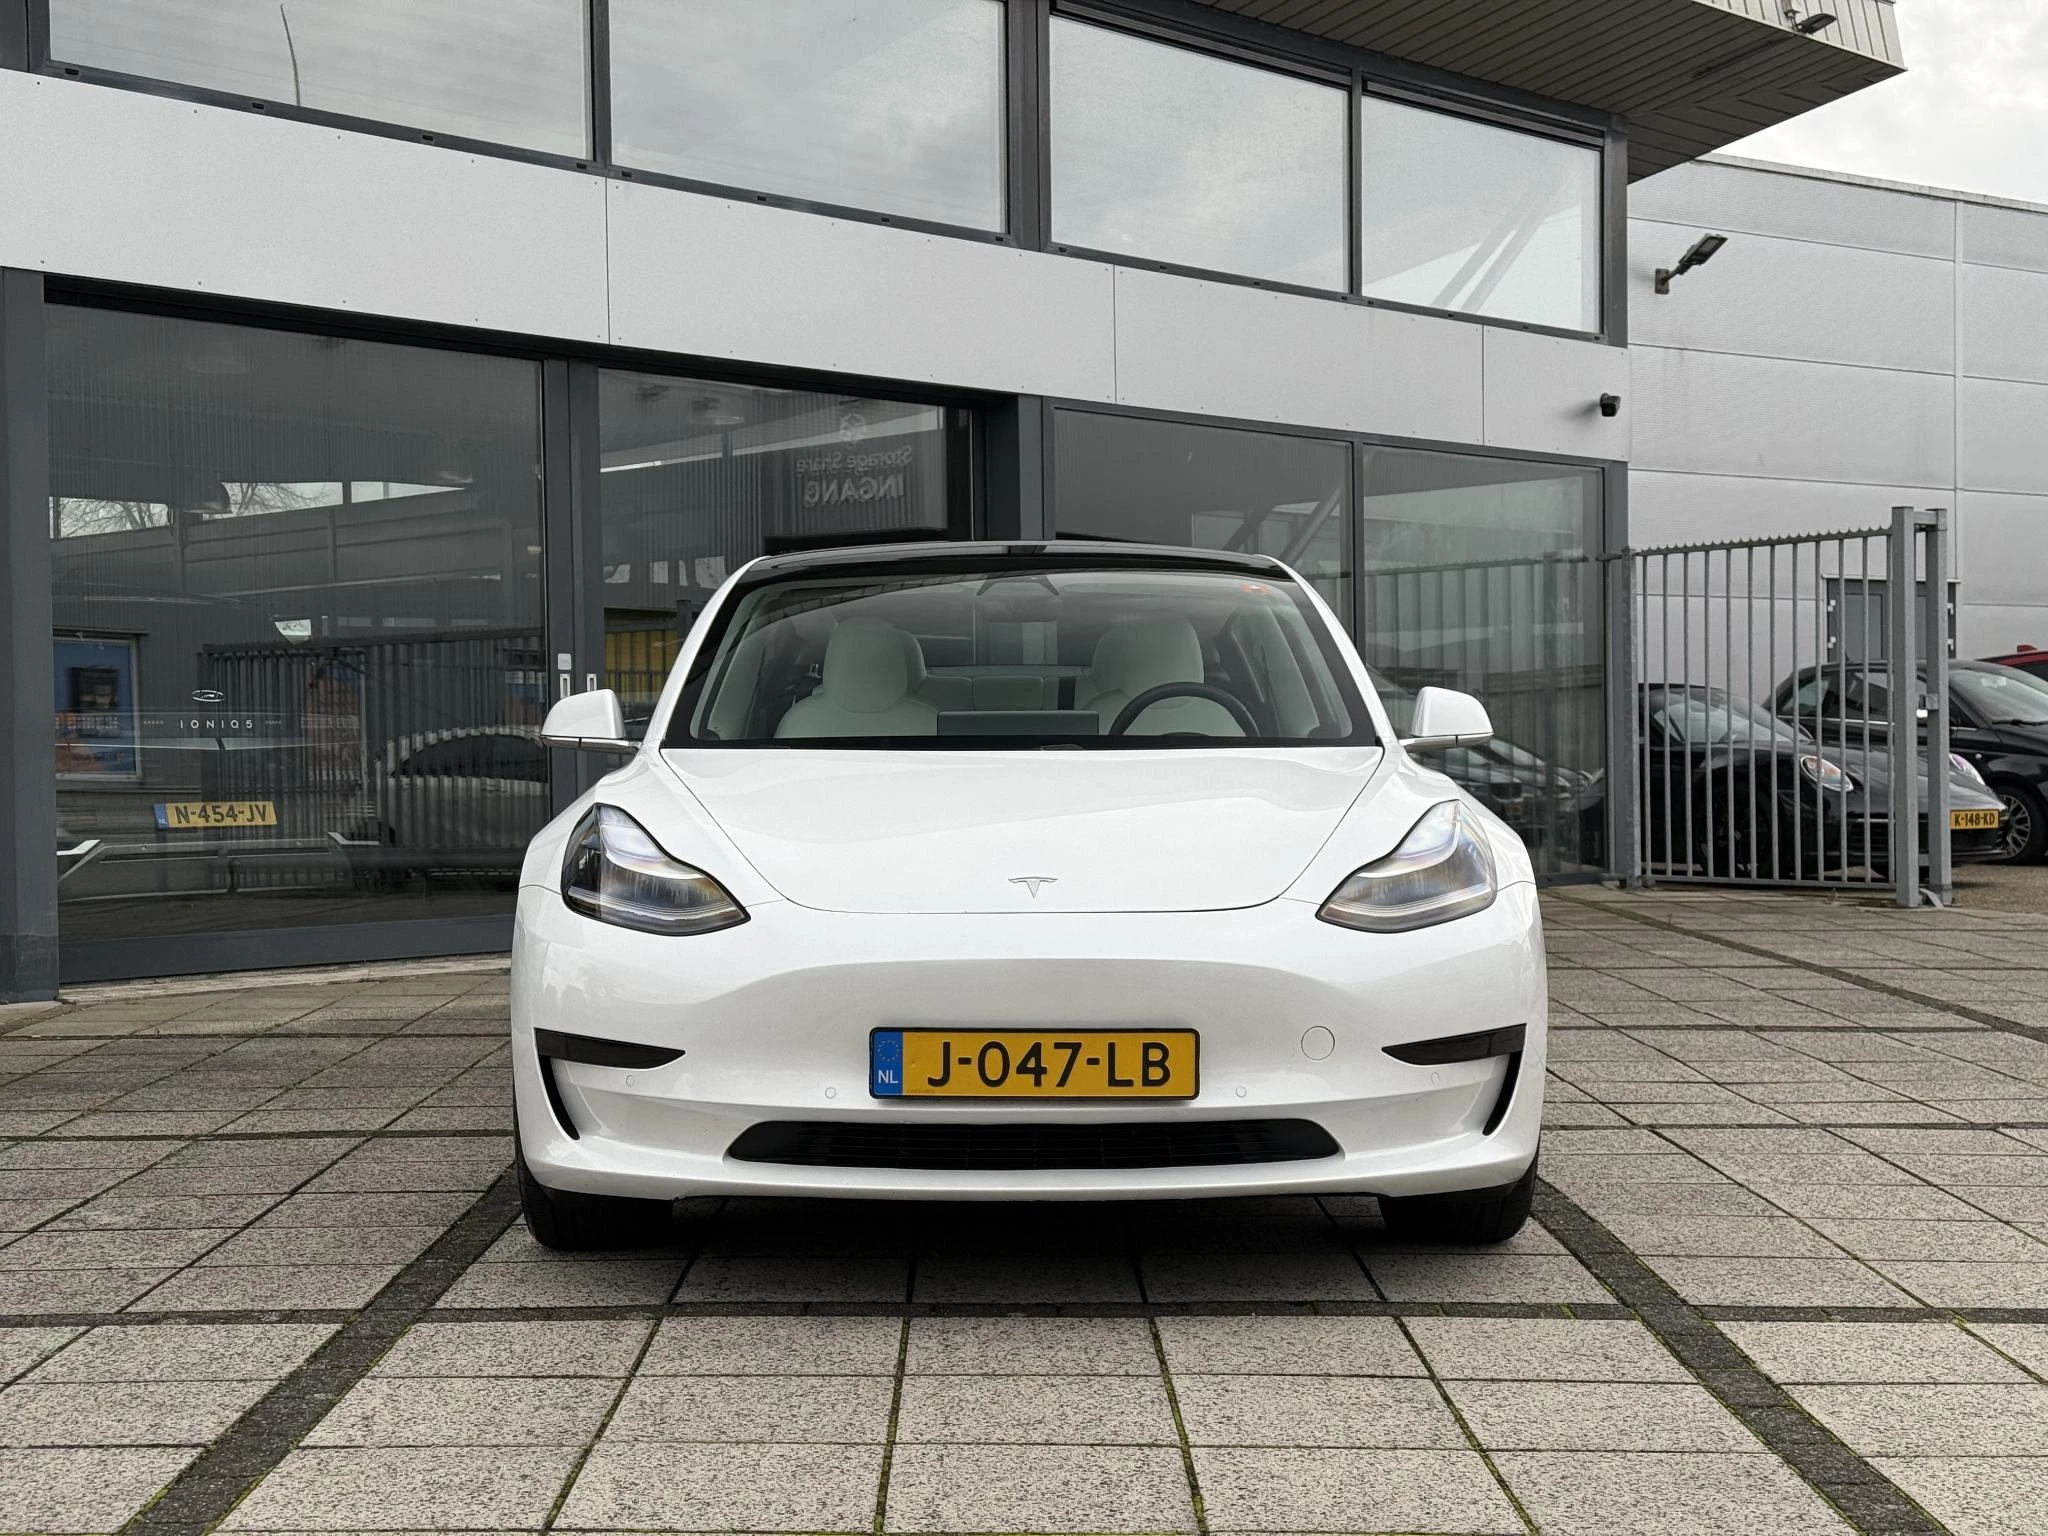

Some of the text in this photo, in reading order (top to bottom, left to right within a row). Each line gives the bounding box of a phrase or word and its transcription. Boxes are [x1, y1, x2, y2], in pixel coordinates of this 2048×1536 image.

[174, 804, 267, 824] N-454-JV
[1954, 812, 1996, 827] K-148-KD
[927, 1040, 1171, 1088] J-047-LB
[877, 1069, 899, 1084] NL
